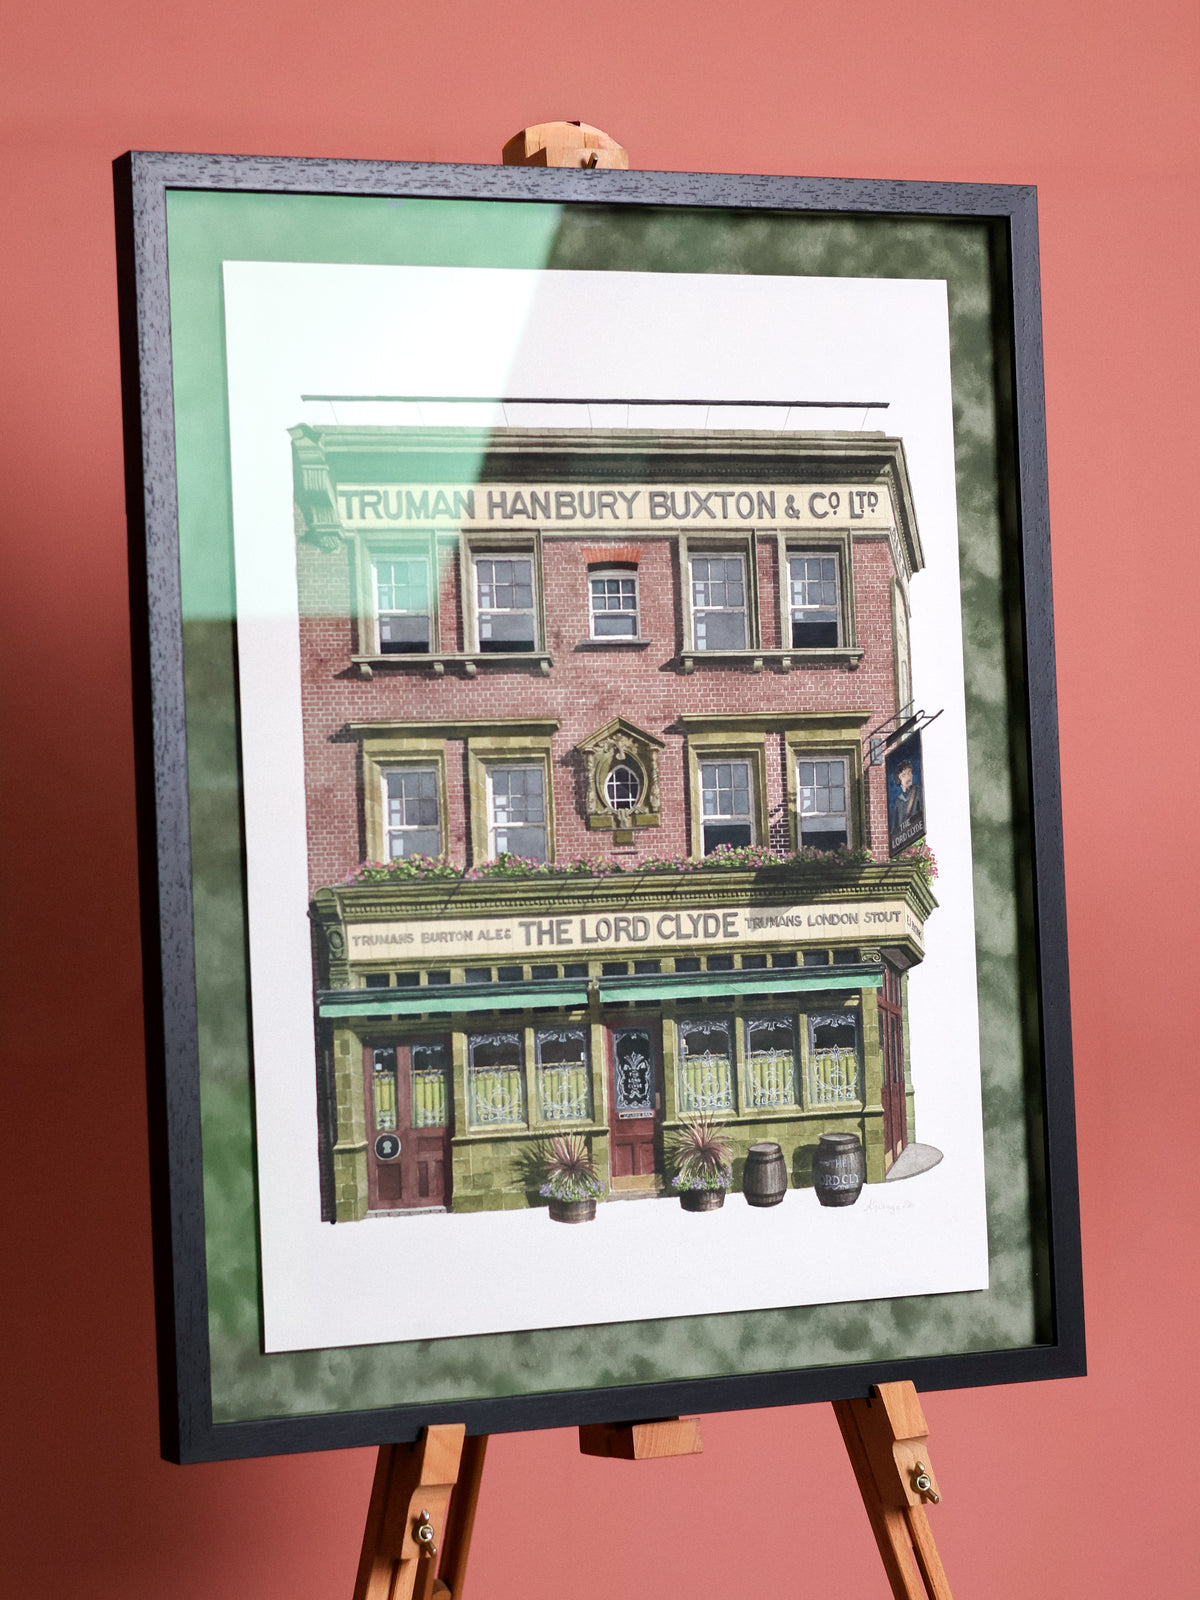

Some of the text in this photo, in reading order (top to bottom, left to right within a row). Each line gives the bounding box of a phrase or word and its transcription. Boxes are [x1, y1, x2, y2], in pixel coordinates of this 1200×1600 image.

[338, 490, 475, 520] TRUMAN
[487, 490, 641, 520] HANBURY
[650, 490, 776, 520] BUXTON
[785, 494, 801, 520] &
[900, 818, 911, 831] THE
[352, 933, 415, 947] TRUMANS
[421, 930, 473, 944] BURTON
[518, 918, 574, 946] THE
[580, 914, 649, 945] LORD
[656, 911, 739, 940] CLYDE
[744, 915, 802, 930] TRUMANS
[807, 912, 859, 928] LONDON
[863, 910, 902, 923] STOUT
[831, 1159, 848, 1169] THE
